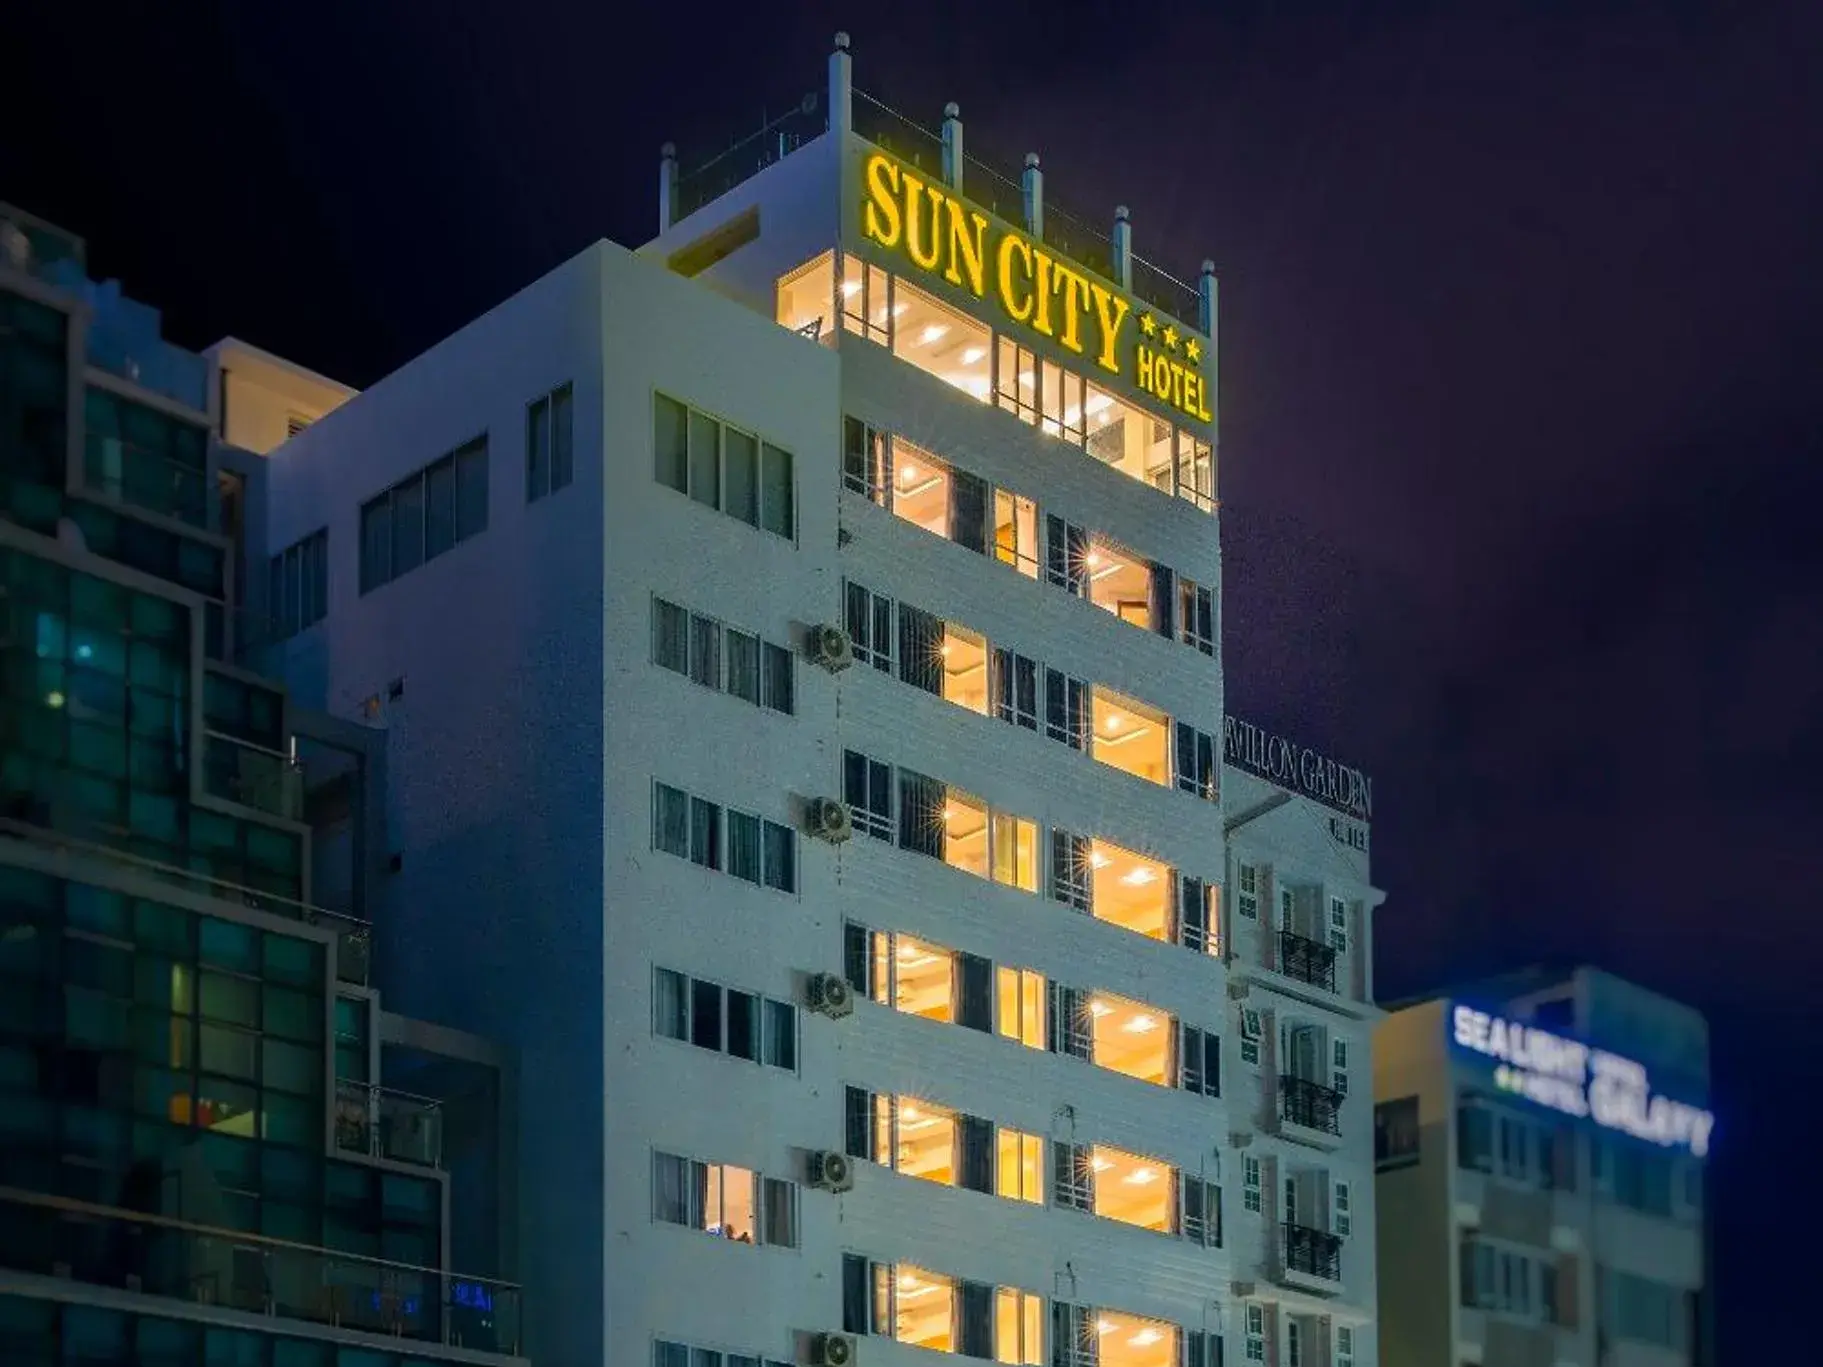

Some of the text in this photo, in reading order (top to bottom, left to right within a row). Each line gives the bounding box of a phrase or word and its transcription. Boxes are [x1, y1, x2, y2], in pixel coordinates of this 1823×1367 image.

[866, 155, 1131, 374] SUN CITY
[1137, 345, 1212, 423] HOTEL
[1301, 748, 1372, 818] GARDEN
